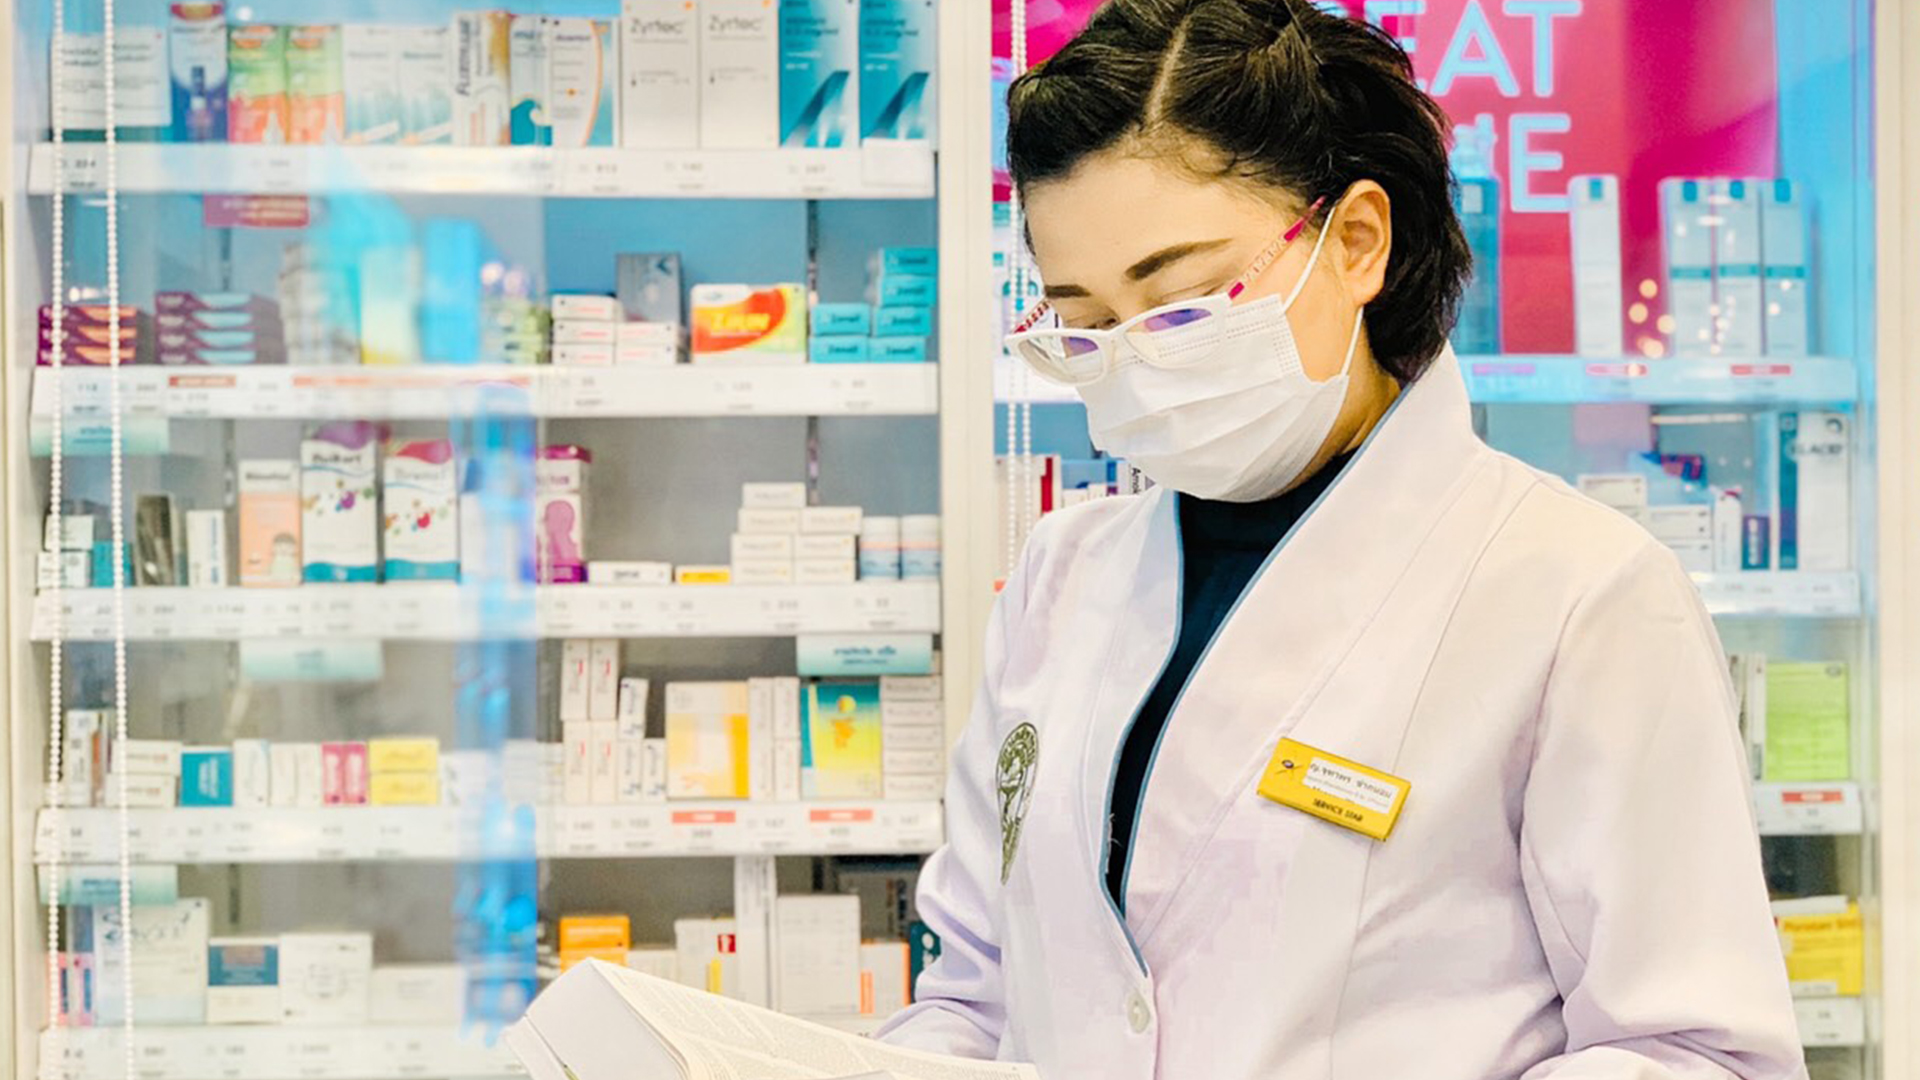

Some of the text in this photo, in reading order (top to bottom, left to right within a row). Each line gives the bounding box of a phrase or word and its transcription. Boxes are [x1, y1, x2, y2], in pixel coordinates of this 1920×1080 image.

[630, 16, 687, 35] Zyrtec
[708, 14, 765, 32] Zyrtec
[1311, 0, 1583, 97] EAT
[1313, 798, 1363, 822] SERVICE STAR
